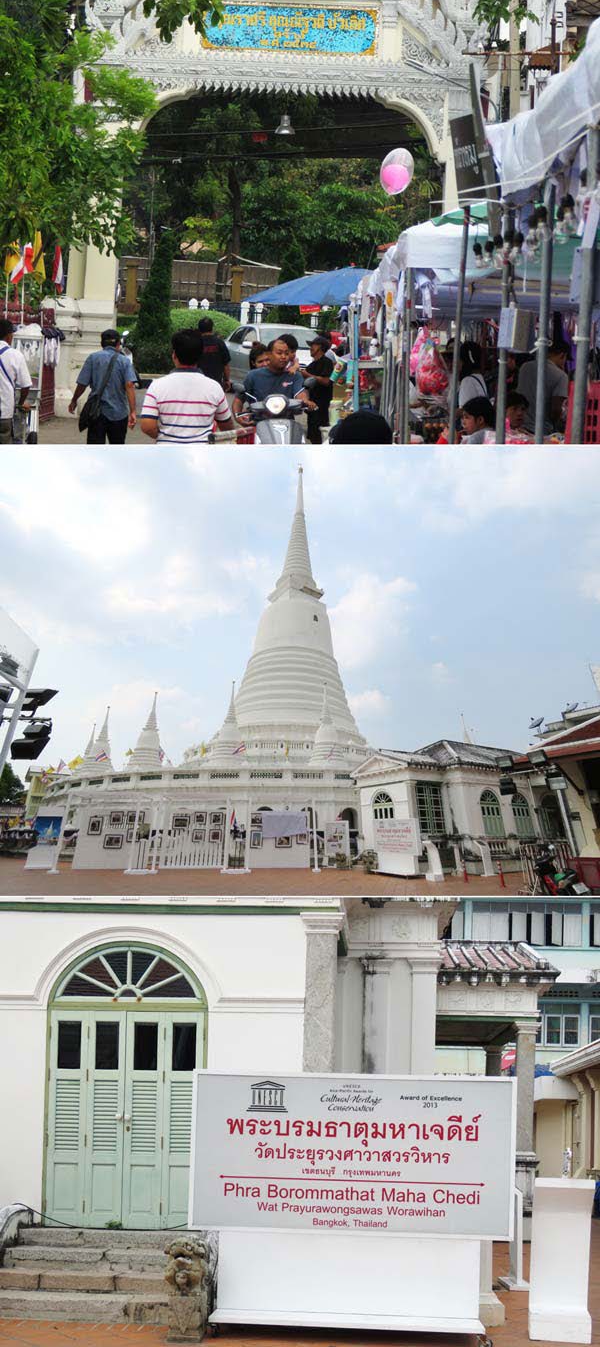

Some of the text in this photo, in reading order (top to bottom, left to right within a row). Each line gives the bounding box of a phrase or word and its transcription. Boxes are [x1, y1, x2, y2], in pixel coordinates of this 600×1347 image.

[320, 1094, 383, 1106] Cultural Heritage
[327, 1103, 375, 1112] Conservation
[226, 1114, 482, 1147] พระบรมธาตุมหาเจดีย์
[254, 1142, 451, 1166] วัดประยุรวงศาวาสวรวิหาร
[301, 1166, 402, 1178] เขตธนบุรี กรุงเทพมหานคร
[223, 1183, 481, 1205] Phra Borommathat Maha Chedi
[257, 1202, 446, 1217] Wat Prayurawongsawas Worawihan
[312, 1218, 388, 1228] Bangkok, Thailand
